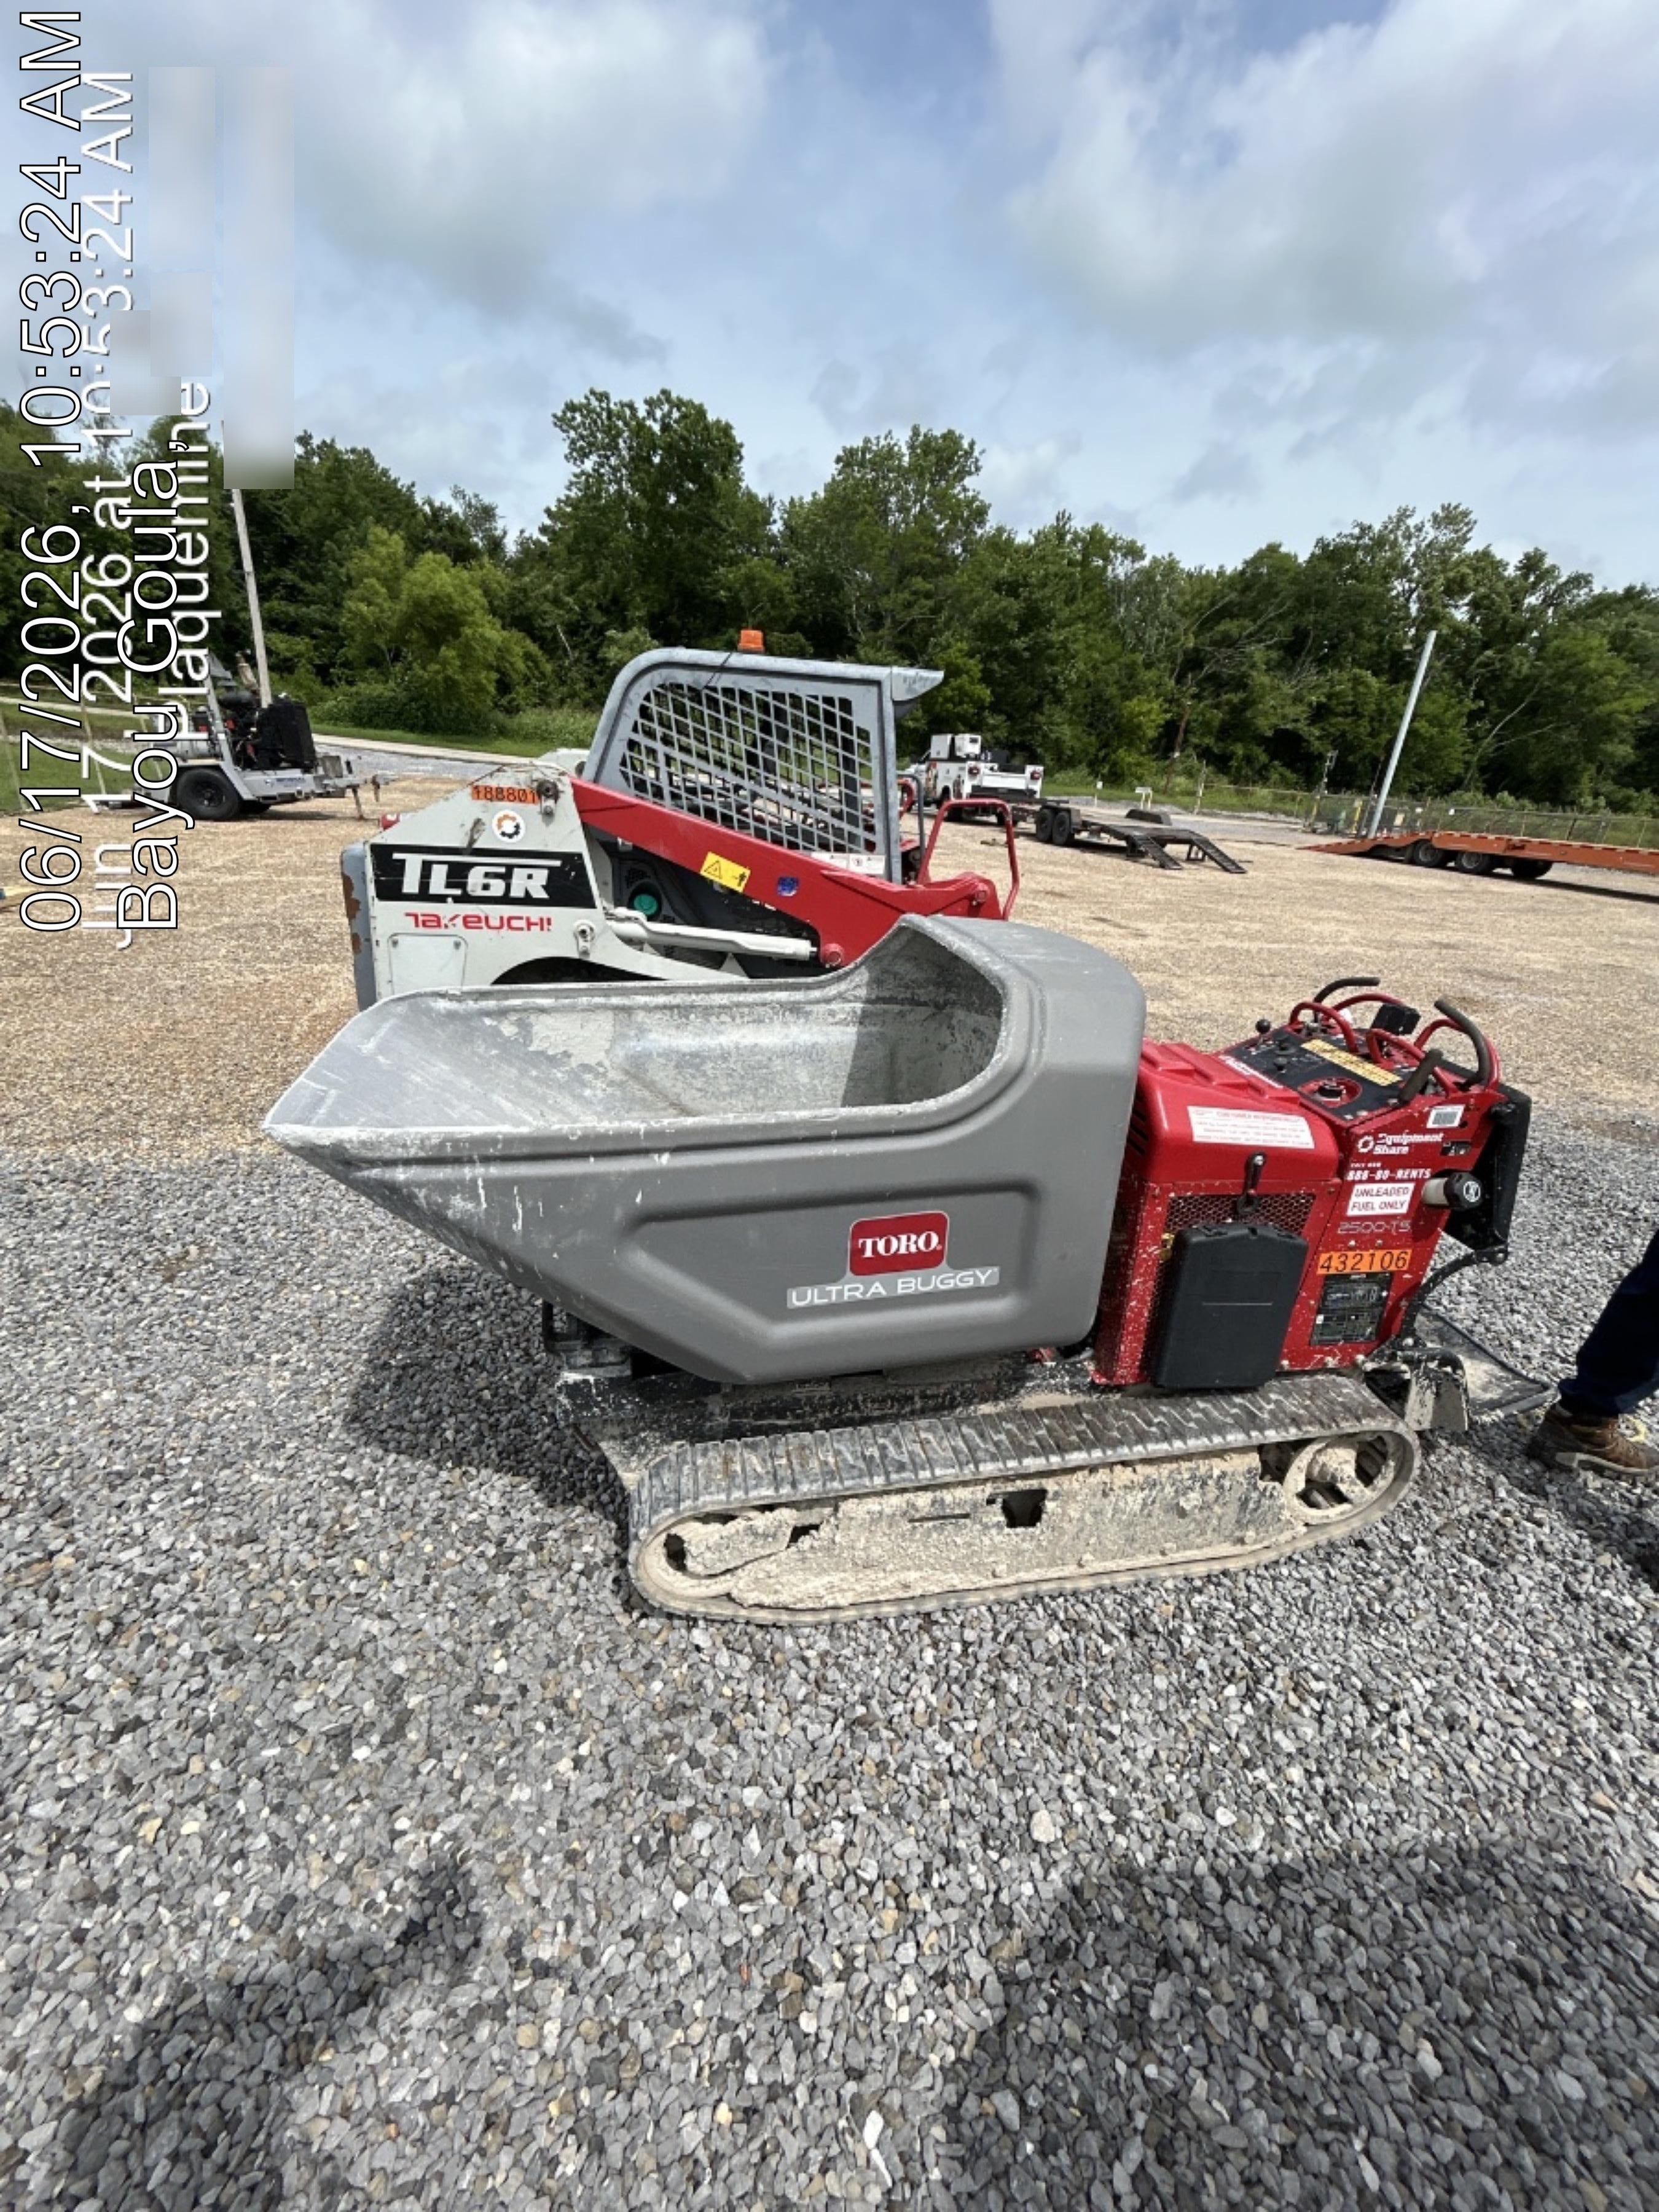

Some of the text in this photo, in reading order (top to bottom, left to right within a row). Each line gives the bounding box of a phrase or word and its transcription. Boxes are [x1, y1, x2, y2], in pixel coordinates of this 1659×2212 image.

[473, 785, 535, 804] 188801
[392, 852, 562, 900] TL6R
[1373, 1144, 1410, 1155] Share
[1354, 1186, 1410, 1198] UNLEADED
[1351, 1199, 1407, 1212] FUEL ONLY
[858, 1230, 940, 1259] TORO
[1319, 1250, 1408, 1273] 432106
[792, 1269, 993, 1307] ULTRA BUGGY
